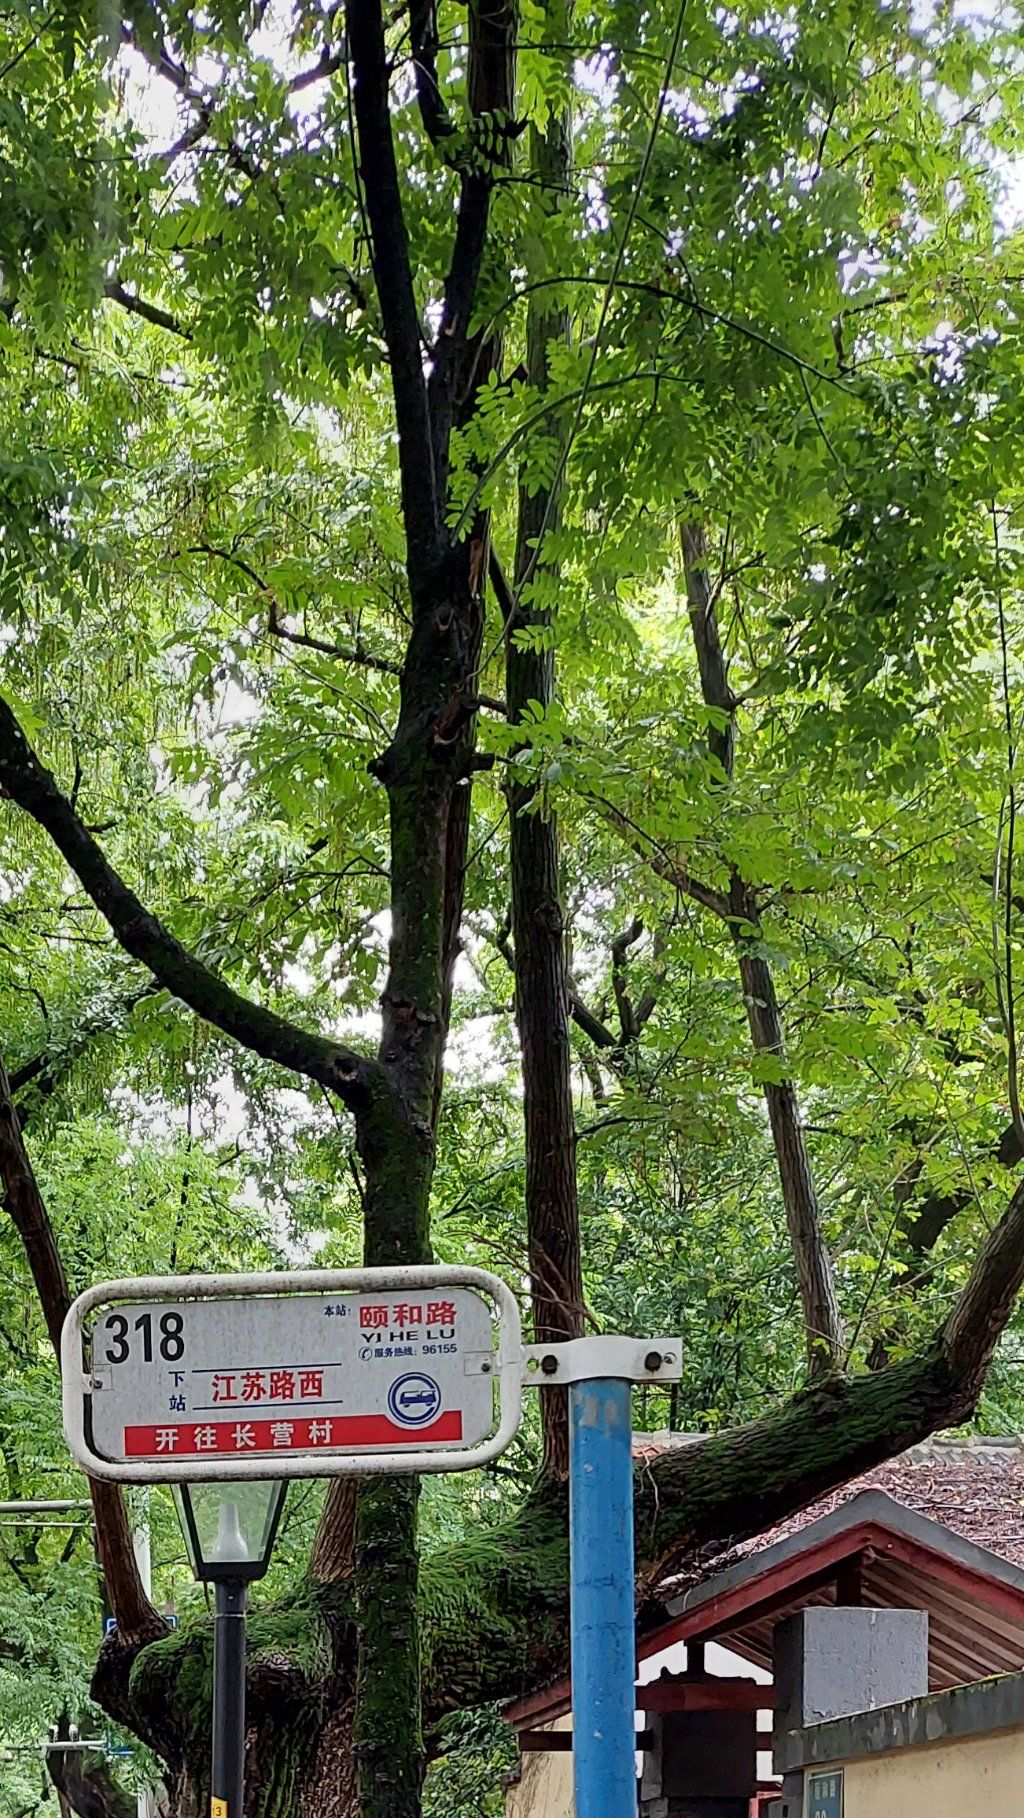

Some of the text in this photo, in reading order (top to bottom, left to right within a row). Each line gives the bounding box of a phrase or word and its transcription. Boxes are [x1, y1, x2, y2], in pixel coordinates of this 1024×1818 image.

[359, 1300, 458, 1329] 颐和路
[105, 1311, 185, 1364] 318
[361, 1328, 455, 1343] YI HE LU
[211, 1370, 325, 1402] 江苏路西
[155, 1419, 333, 1451] 开往长营村
